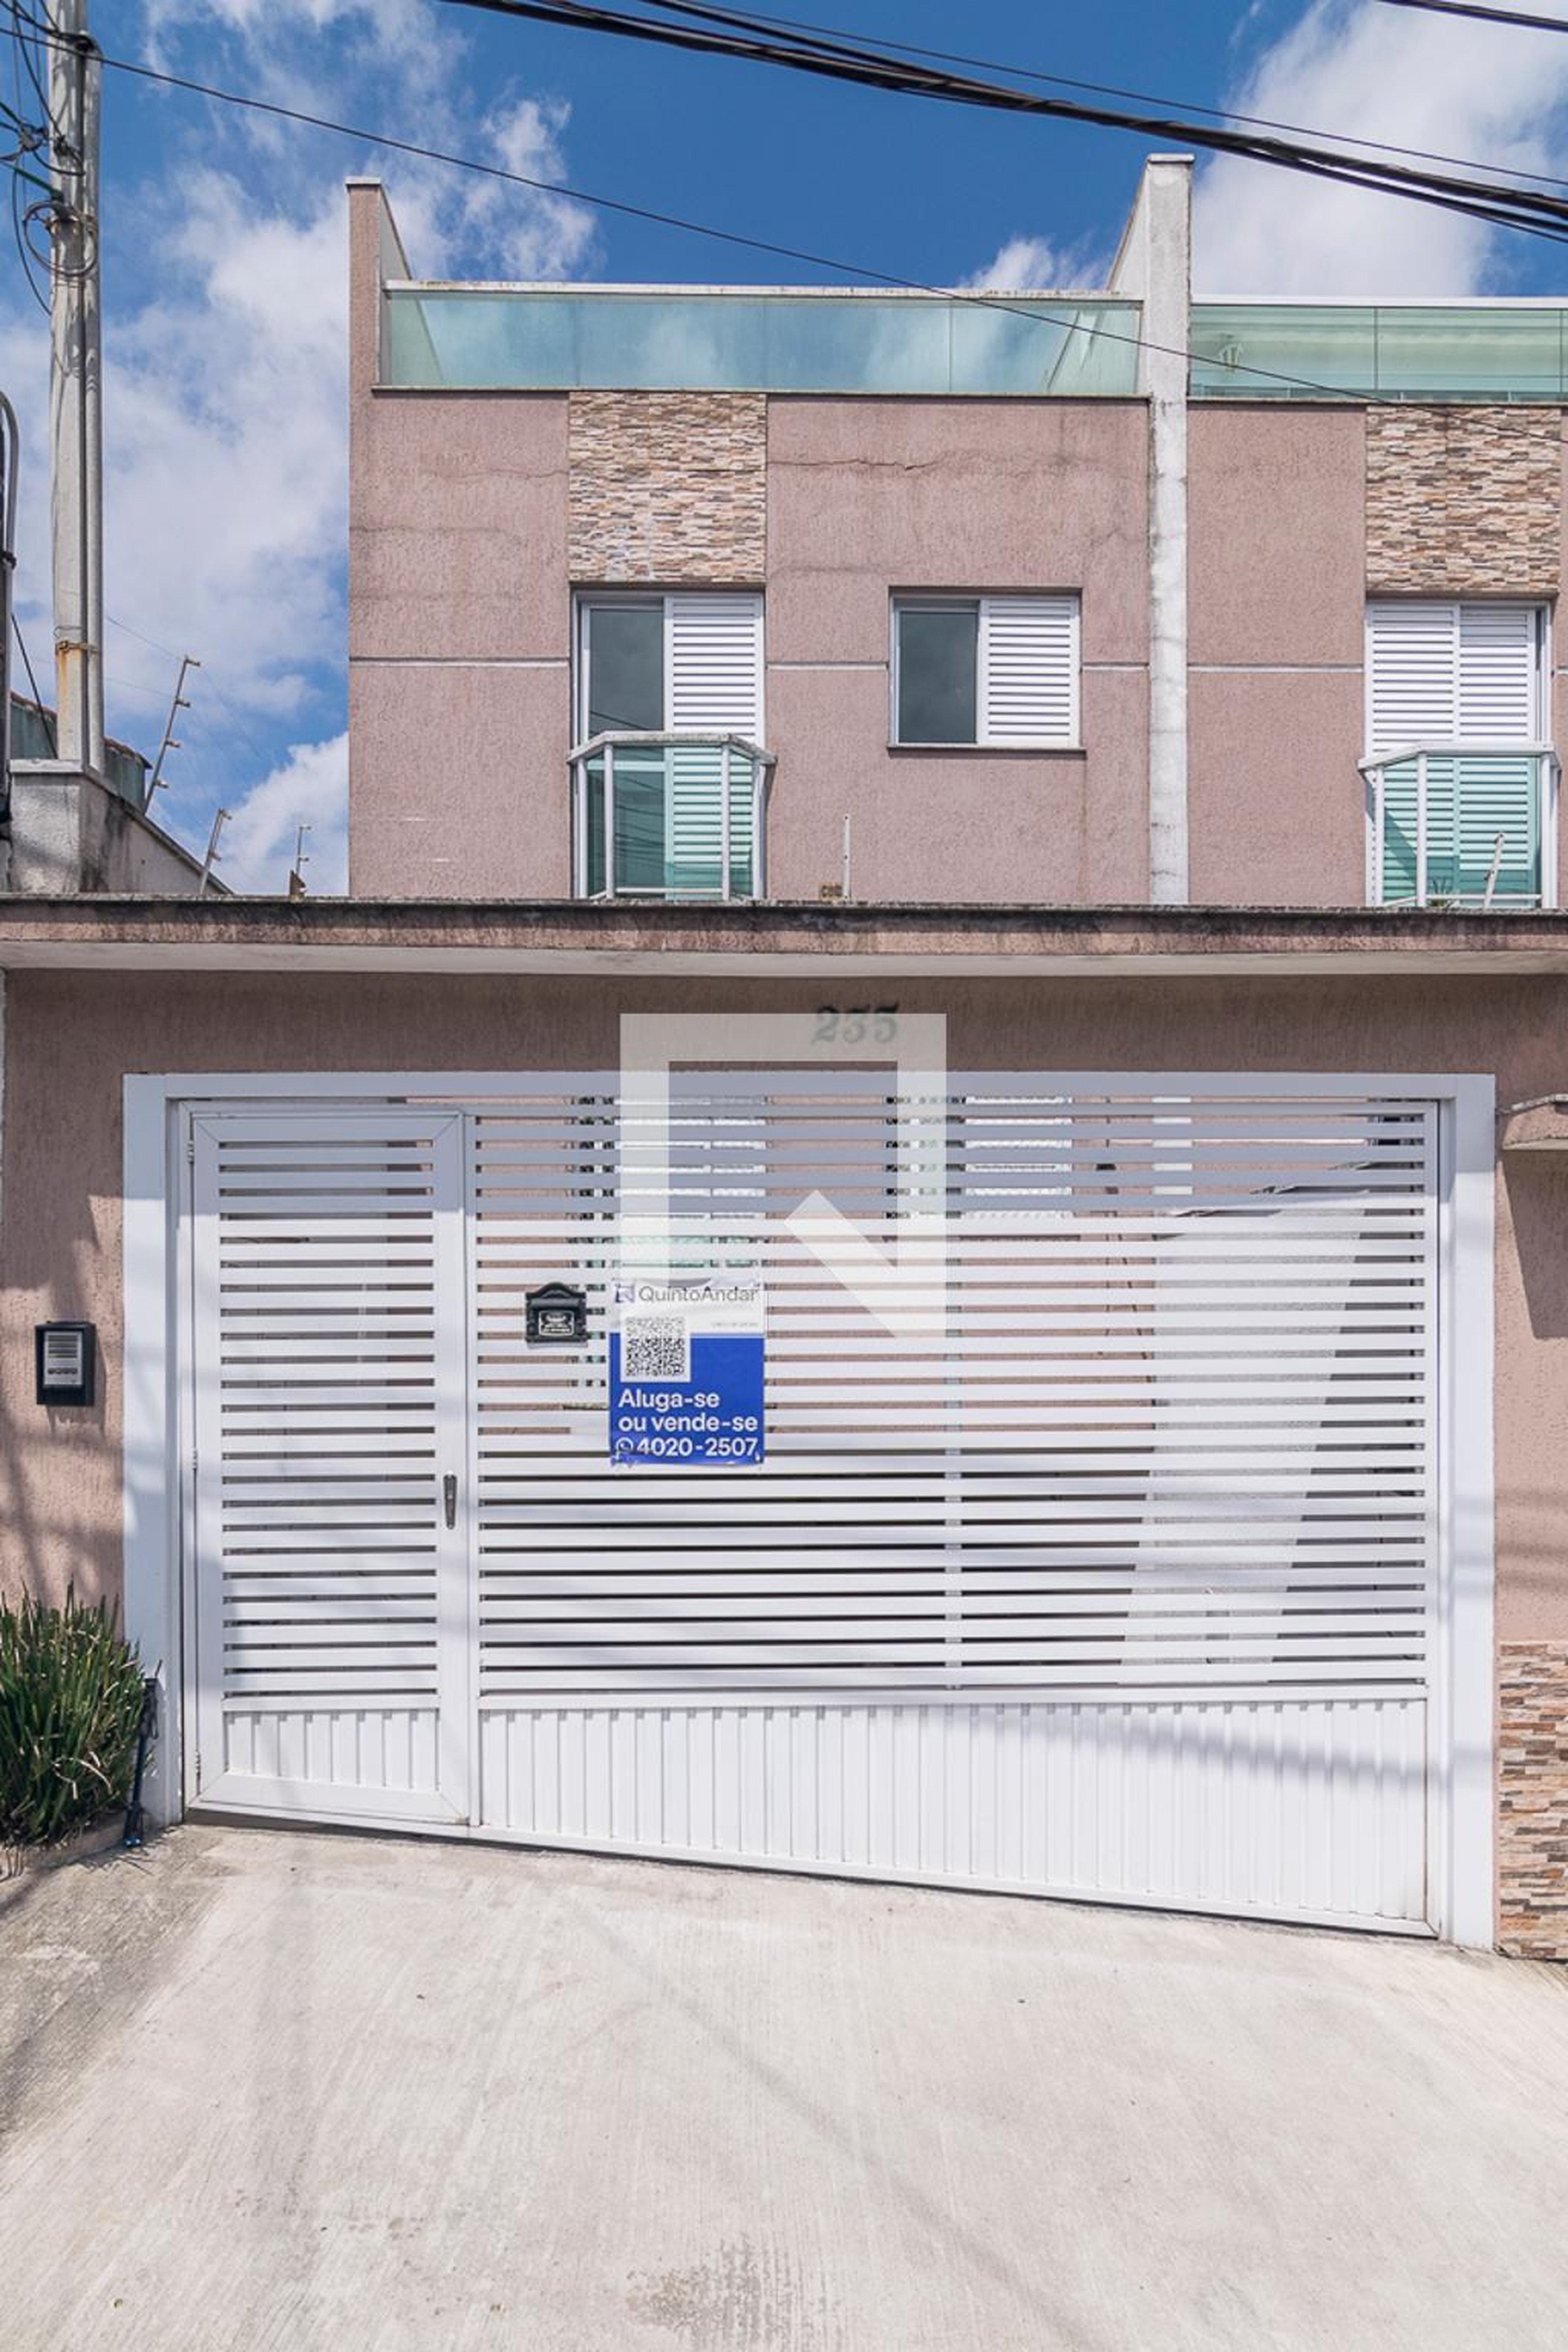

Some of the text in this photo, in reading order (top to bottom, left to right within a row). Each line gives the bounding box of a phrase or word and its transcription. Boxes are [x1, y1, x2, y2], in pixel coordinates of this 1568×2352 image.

[639, 1286, 758, 1302] QuintoAndar
[619, 1389, 720, 1412] Aluga-se
[619, 1413, 758, 1432] ou vende-se
[637, 1437, 758, 1457] 4020-2507
